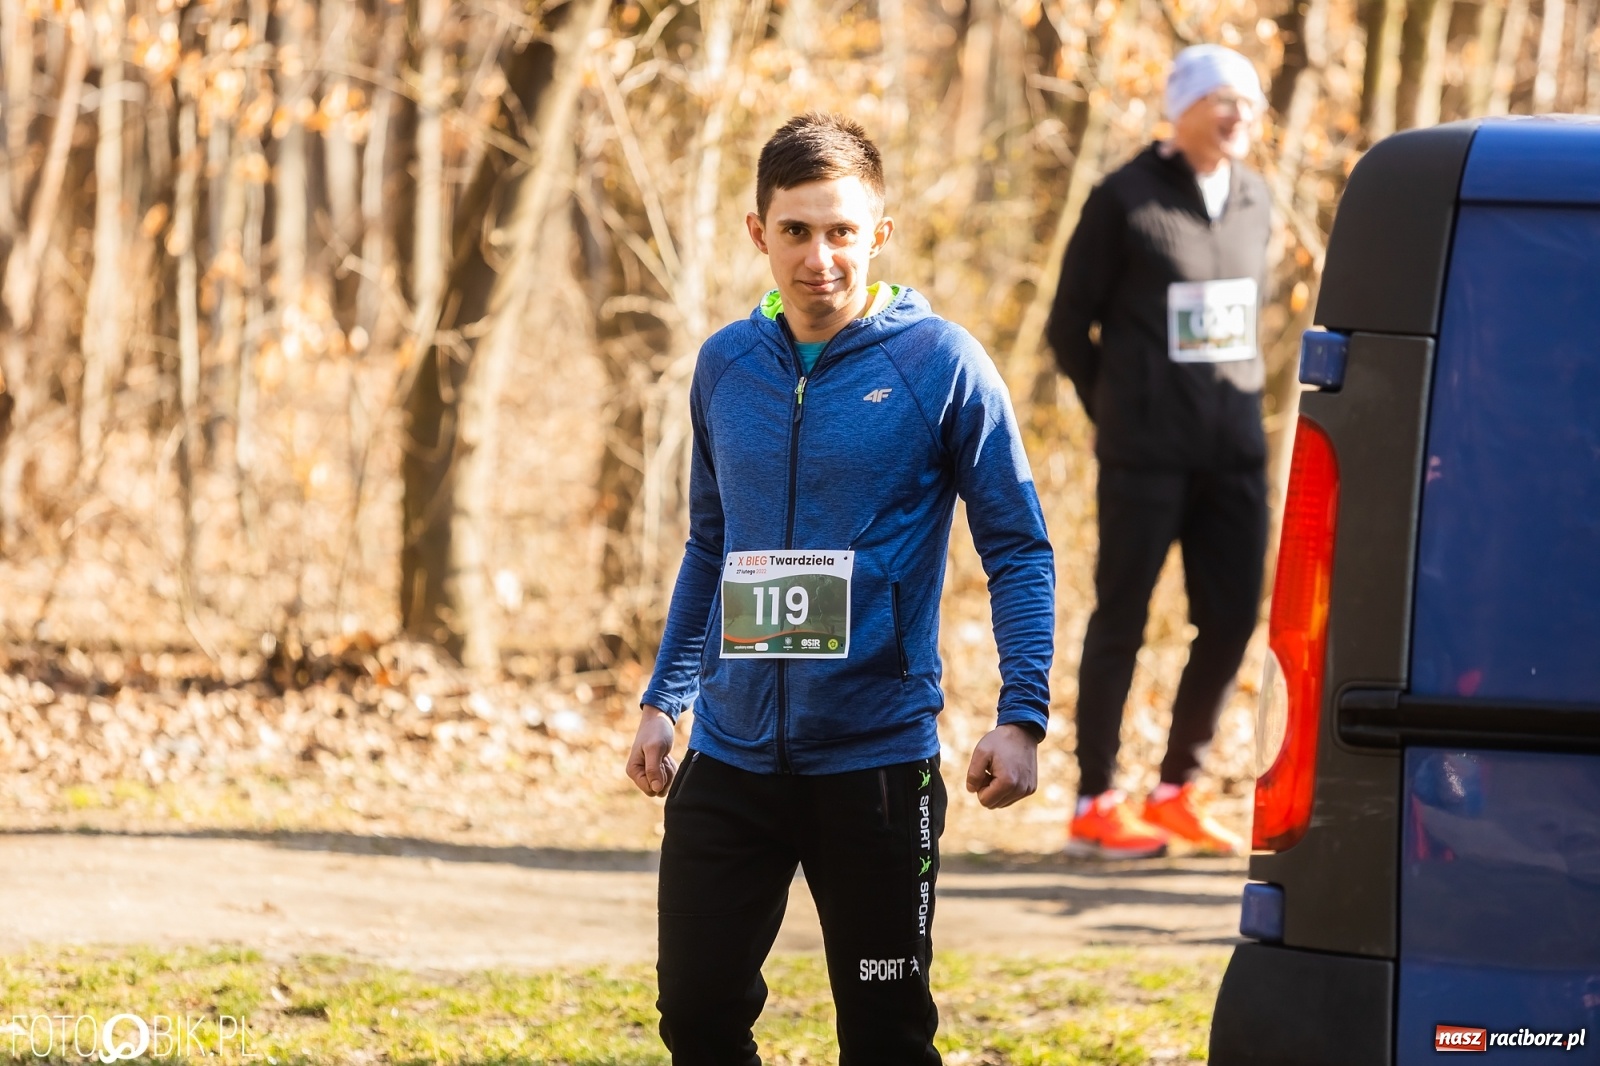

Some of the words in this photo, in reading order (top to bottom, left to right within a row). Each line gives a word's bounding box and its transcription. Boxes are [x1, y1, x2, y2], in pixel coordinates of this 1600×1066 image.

[863, 388, 892, 403] 4F
[738, 556, 745, 566] X
[746, 556, 767, 566] BIEG
[769, 555, 834, 566] Twardziela
[753, 586, 809, 625] 119
[919, 795, 931, 850] SPORT
[918, 881, 929, 937] SPORT
[859, 958, 905, 981] SPORT
